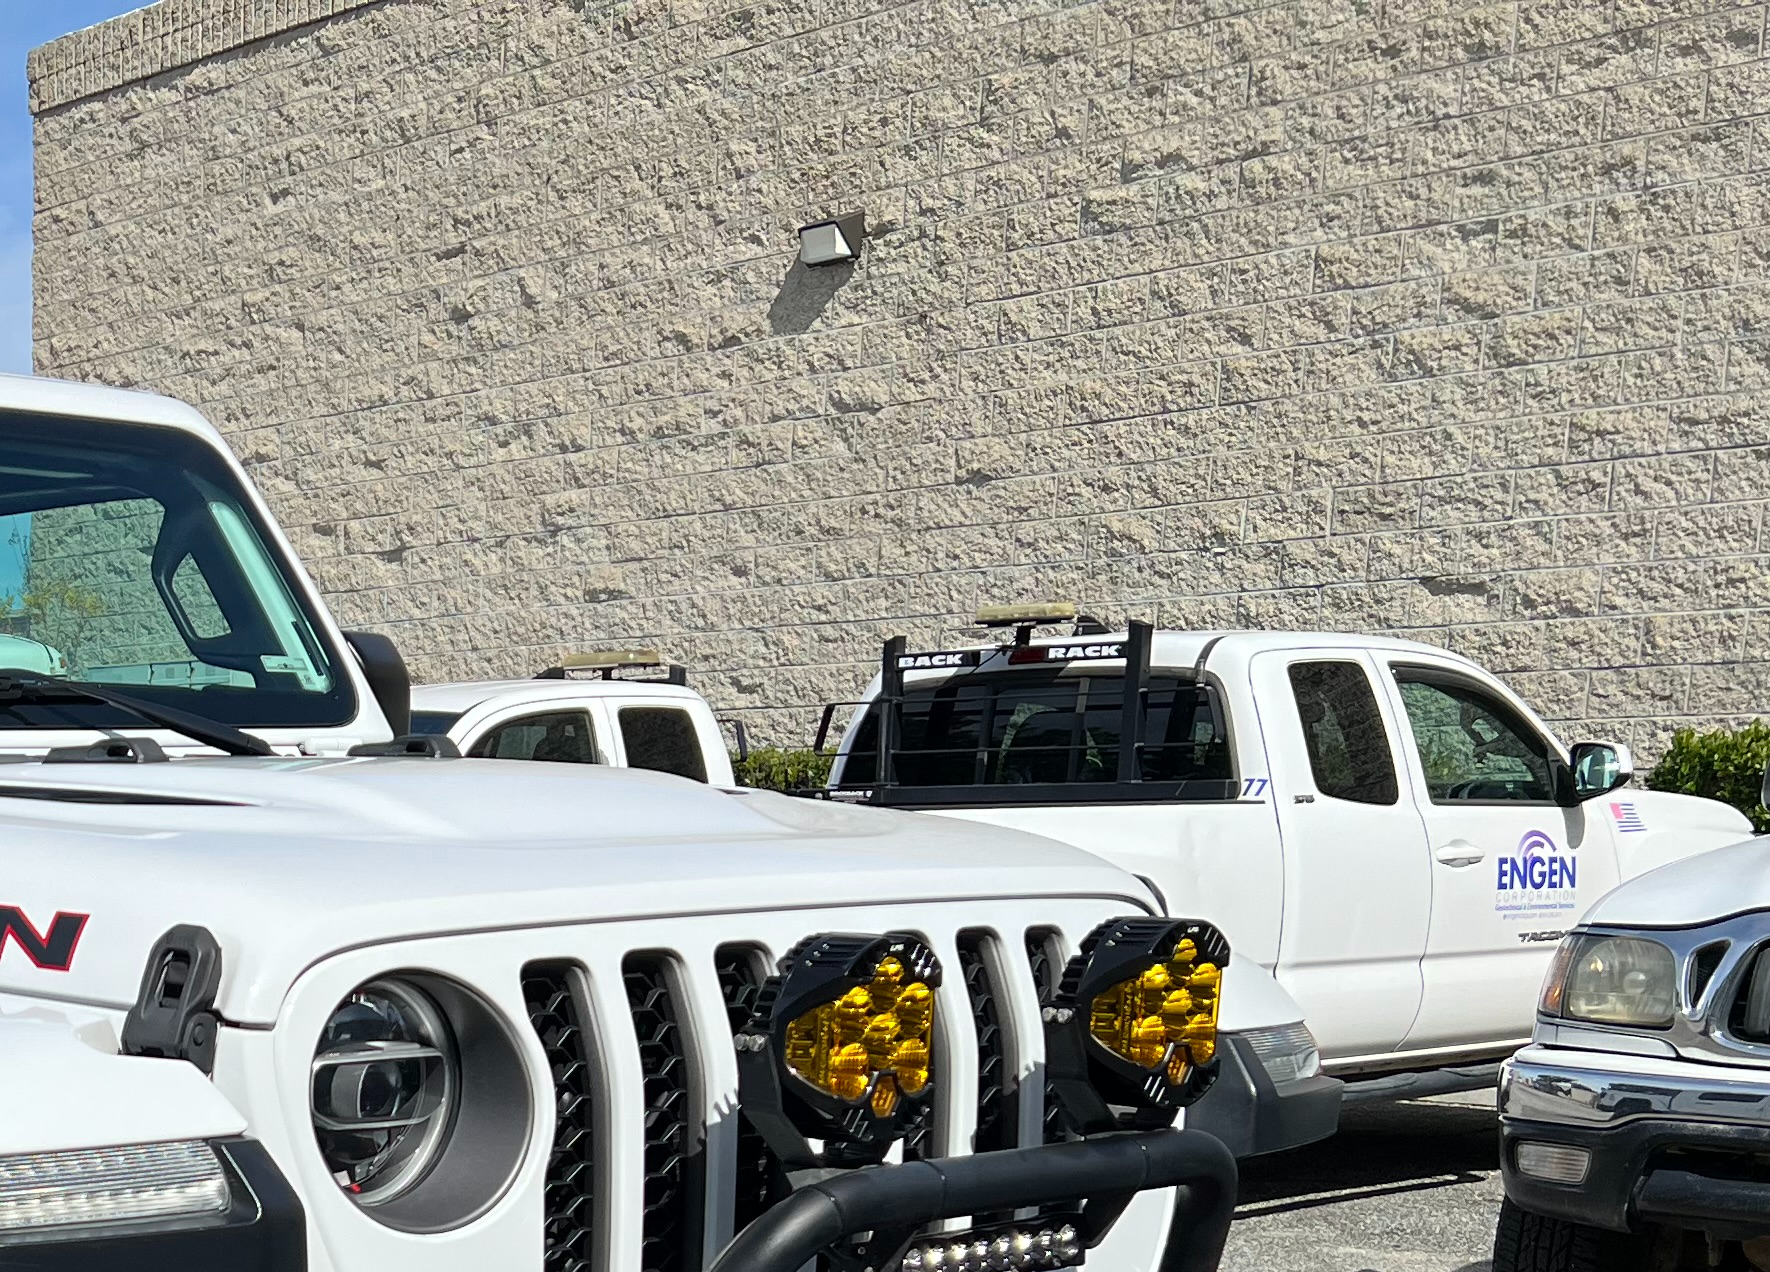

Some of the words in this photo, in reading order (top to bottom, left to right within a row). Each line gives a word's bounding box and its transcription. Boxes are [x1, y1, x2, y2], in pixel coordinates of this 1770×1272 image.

[898, 653, 963, 668] BACK
[1048, 644, 1120, 660] RACK
[1242, 778, 1269, 797] 77
[1496, 855, 1577, 891] ENGEN
[1494, 890, 1576, 904] CORPORATION
